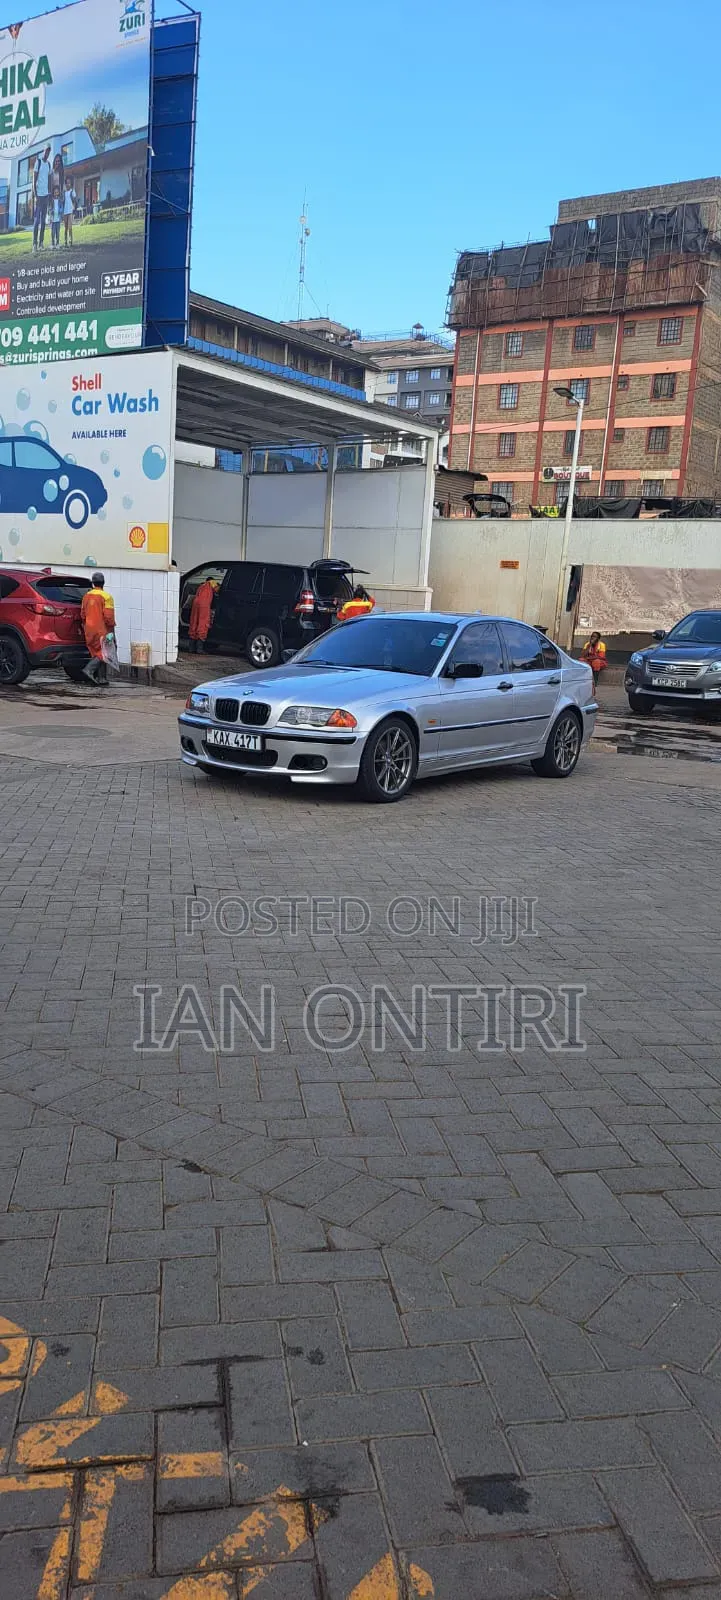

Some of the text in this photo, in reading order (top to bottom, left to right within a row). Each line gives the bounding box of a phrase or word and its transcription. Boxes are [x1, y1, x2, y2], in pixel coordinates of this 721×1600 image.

[119, 12, 145, 32] ZURI
[0, 97, 46, 135] EAL
[10, 134, 29, 148] ZURI
[41, 265, 55, 275] plots
[56, 263, 68, 273] and
[69, 262, 87, 271] larger
[16, 275, 89, 292] Buy and build your home
[104, 272, 140, 287] 3-YEAR
[16, 287, 96, 304] Electricity and water on site
[16, 302, 87, 316] Controlled development
[0, 319, 98, 347] 09 441 441
[72, 372, 102, 391] Shell
[72, 388, 159, 416] Car Wash
[72, 429, 127, 440] AVAILABLE HERE
[213, 730, 258, 749] KAX 417T
